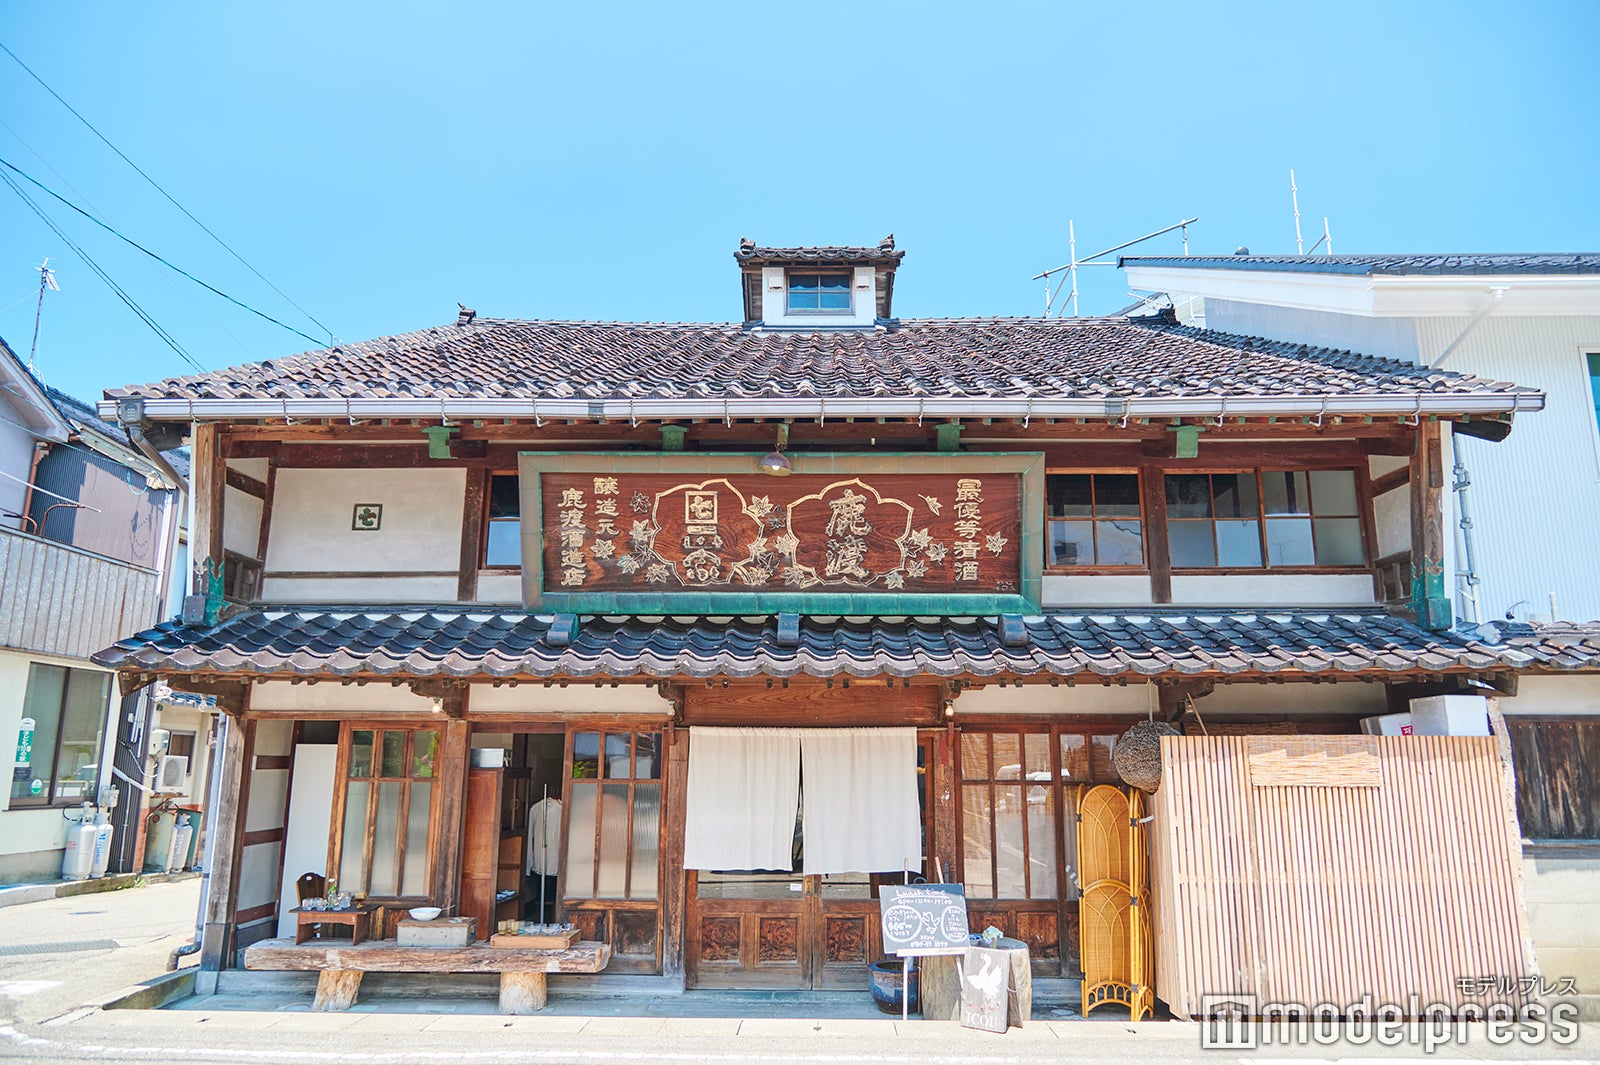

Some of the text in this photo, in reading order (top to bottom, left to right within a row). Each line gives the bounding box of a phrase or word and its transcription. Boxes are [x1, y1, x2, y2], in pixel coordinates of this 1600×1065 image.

[558, 488, 587, 586] 鹿渡酒造店
